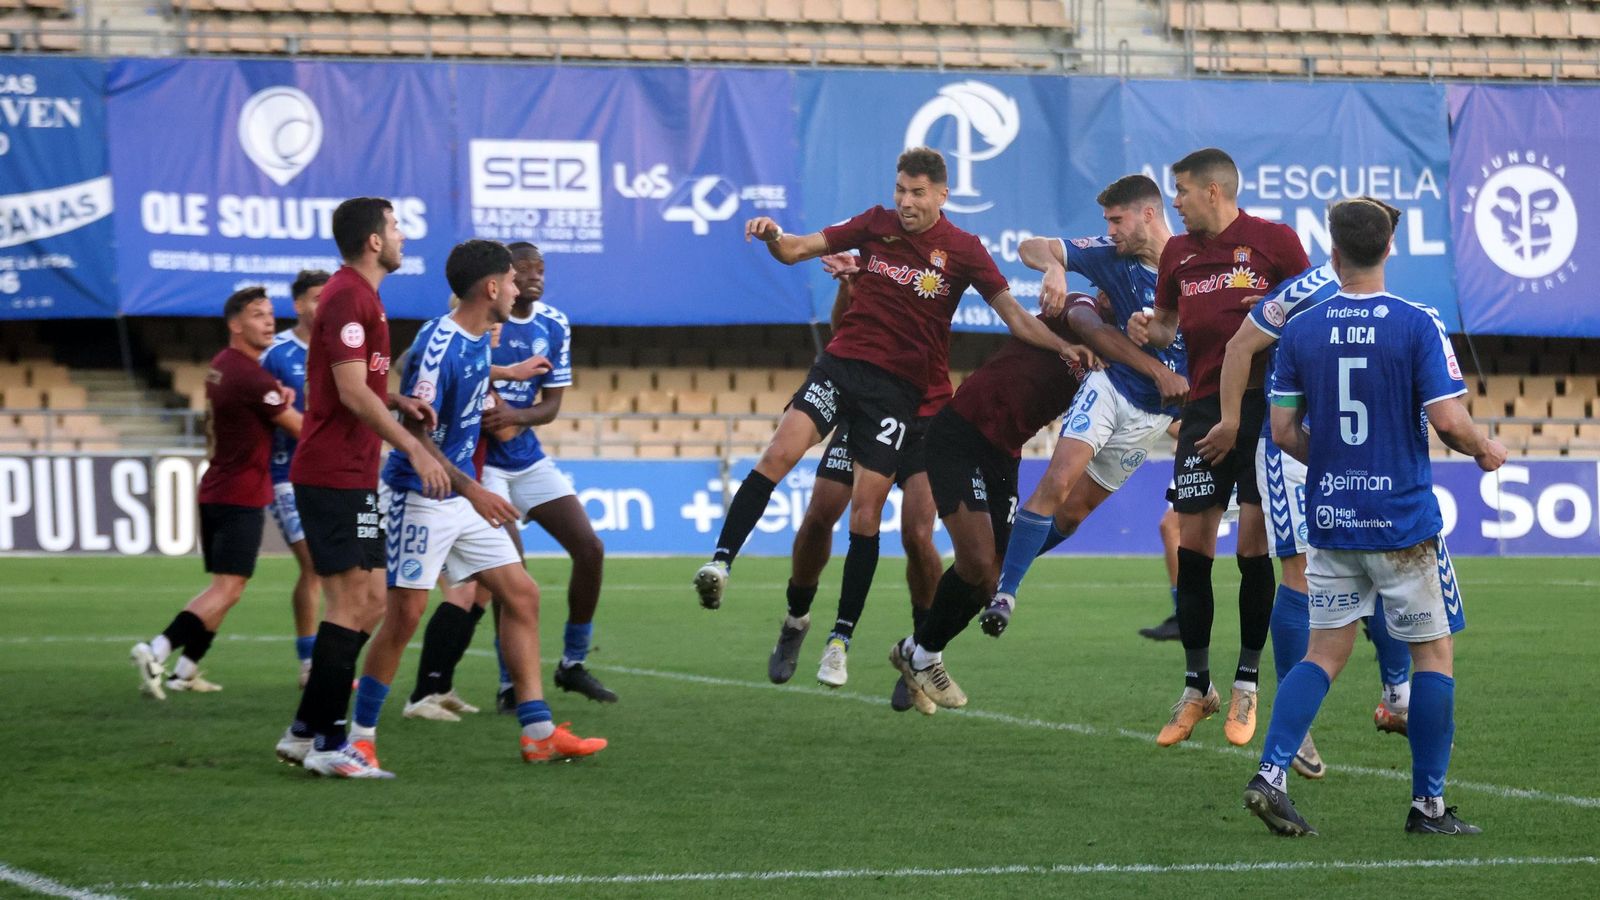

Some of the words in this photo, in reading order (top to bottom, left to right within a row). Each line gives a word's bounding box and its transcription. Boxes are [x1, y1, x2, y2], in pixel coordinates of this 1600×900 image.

[484, 157, 587, 190] SER
[1141, 164, 1440, 201] AU-ESCUELA
[1462, 186, 1478, 214] LA
[1481, 149, 1566, 179] JUNGLA
[141, 191, 209, 237] OLE
[217, 195, 428, 241] SOLUTS
[471, 208, 541, 227] RADIO
[545, 209, 602, 229] JEREZ
[213, 255, 231, 273] DE
[1517, 259, 1578, 293] JEREZ
[1326, 306, 1369, 318] indeso
[1330, 326, 1344, 344] A.
[1347, 326, 1375, 344] OCA
[803, 391, 833, 423] EMPLEO
[809, 383, 837, 414] MODERA
[1338, 357, 1368, 446] 5
[875, 417, 906, 451] 21
[1178, 483, 1216, 500] EMPLEO
[1335, 507, 1357, 520] High
[1335, 518, 1393, 528] ProNutrition
[404, 524, 429, 554] 23
[1310, 592, 1360, 608] REYES
